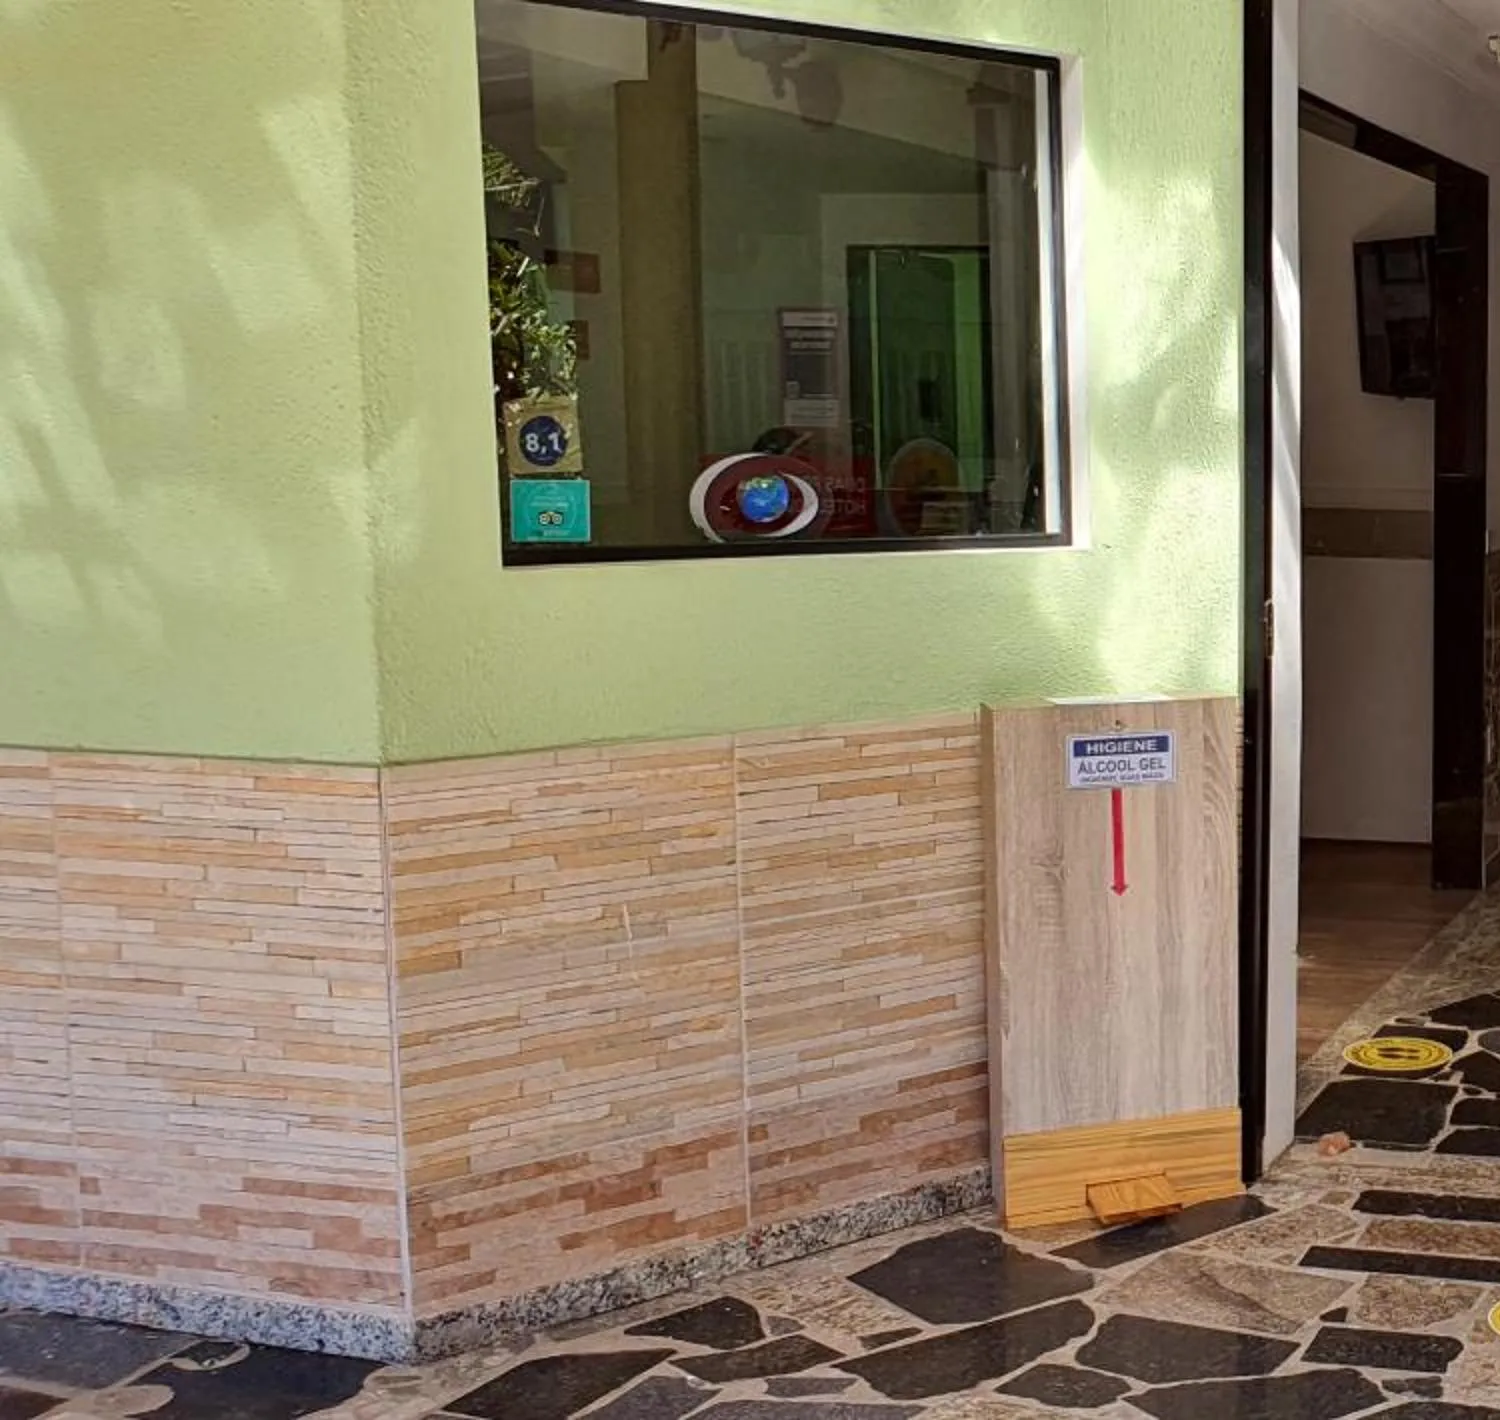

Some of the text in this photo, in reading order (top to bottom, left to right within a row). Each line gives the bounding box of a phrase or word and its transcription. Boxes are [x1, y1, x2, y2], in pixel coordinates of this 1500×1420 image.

[525, 432, 562, 454] 8,1
[1086, 739, 1158, 755] HIGIENE
[1139, 757, 1167, 770] GEL
